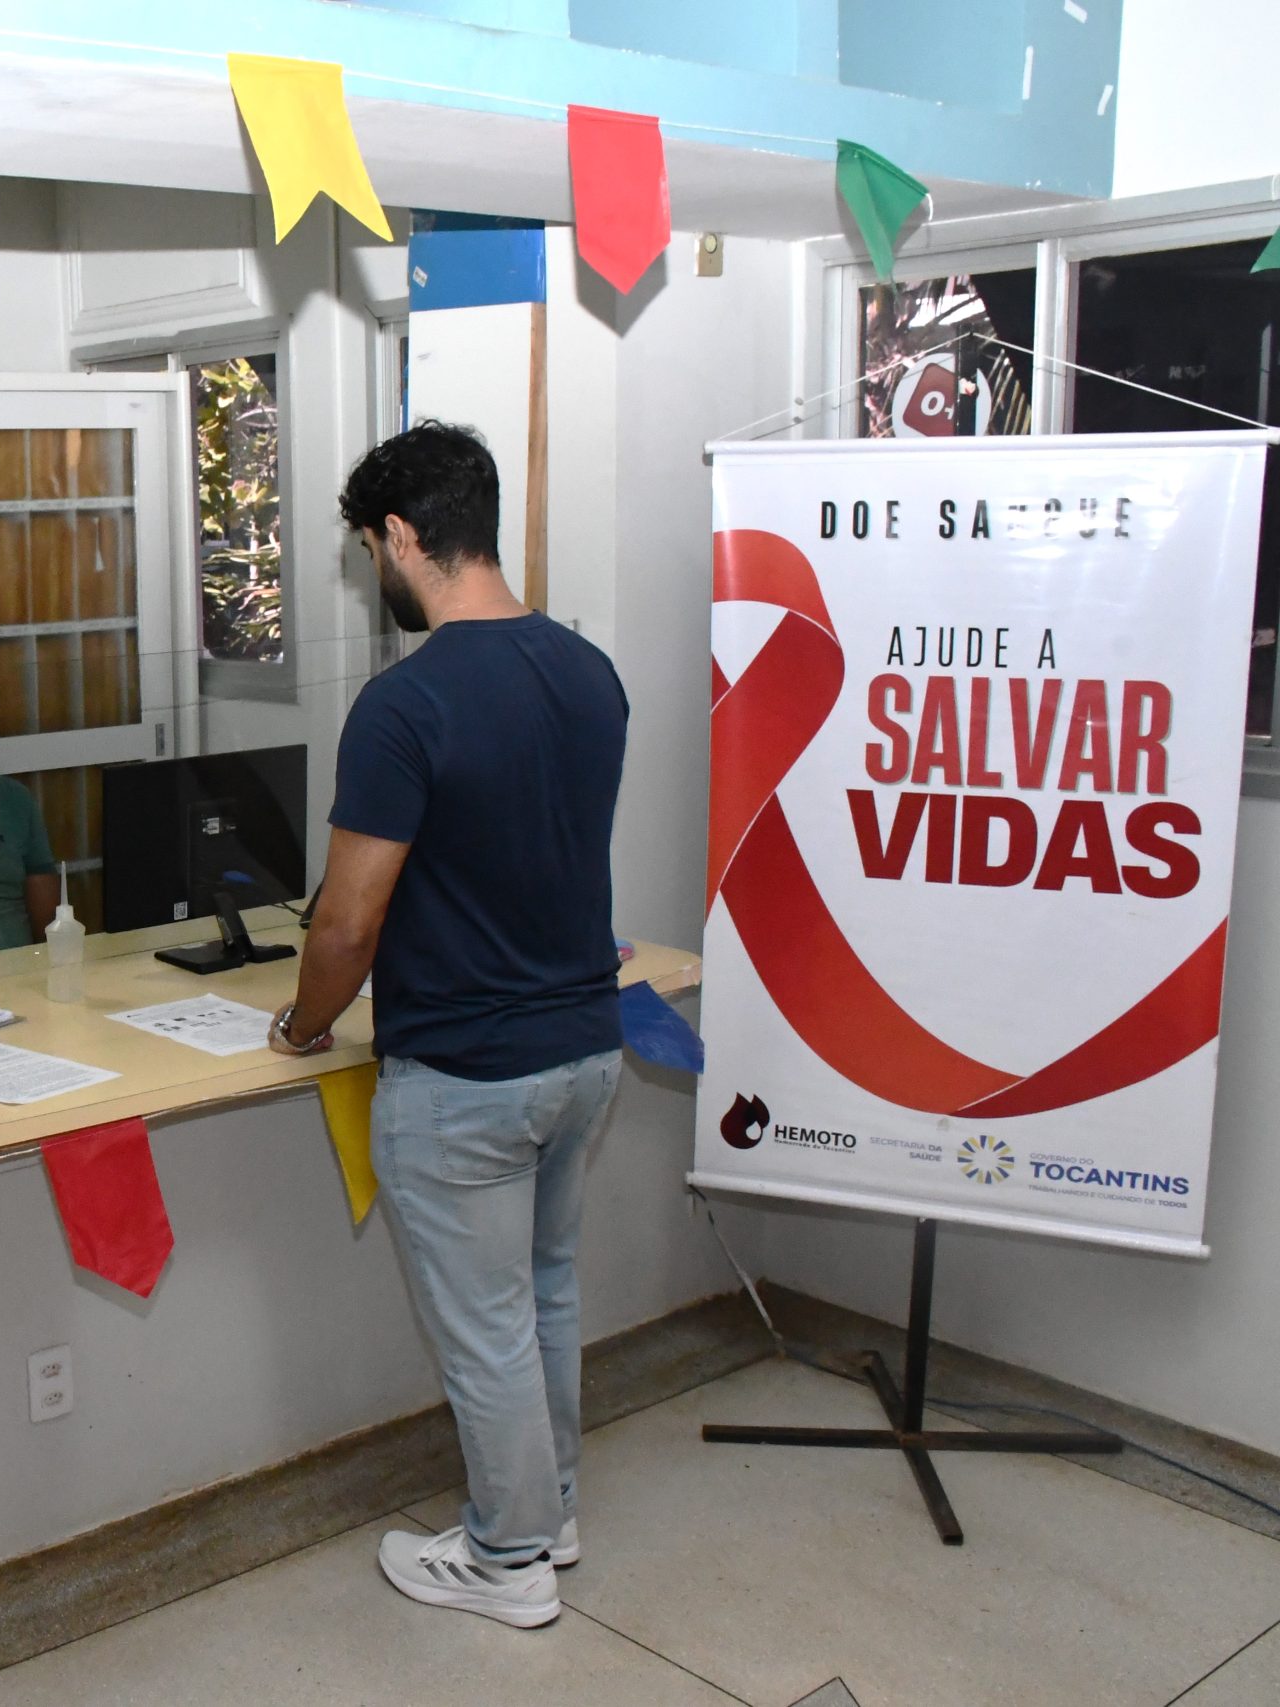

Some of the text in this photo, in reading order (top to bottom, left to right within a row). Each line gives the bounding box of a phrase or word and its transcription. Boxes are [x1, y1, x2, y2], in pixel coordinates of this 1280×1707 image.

[820, 497, 1132, 540] DOE SAUE
[886, 626, 1056, 669] AJUDE A
[865, 673, 1173, 795] SALVAR
[846, 788, 1202, 899] VIDAS
[774, 1124, 857, 1149] HEMOTO
[870, 1136, 942, 1153] SECRETARIA DA
[909, 1150, 942, 1162] SAÚDE
[1029, 1152, 1094, 1166] GOVERNO DO
[1029, 1161, 1189, 1195] TOCANTINS
[1158, 1199, 1188, 1209] TODOS
